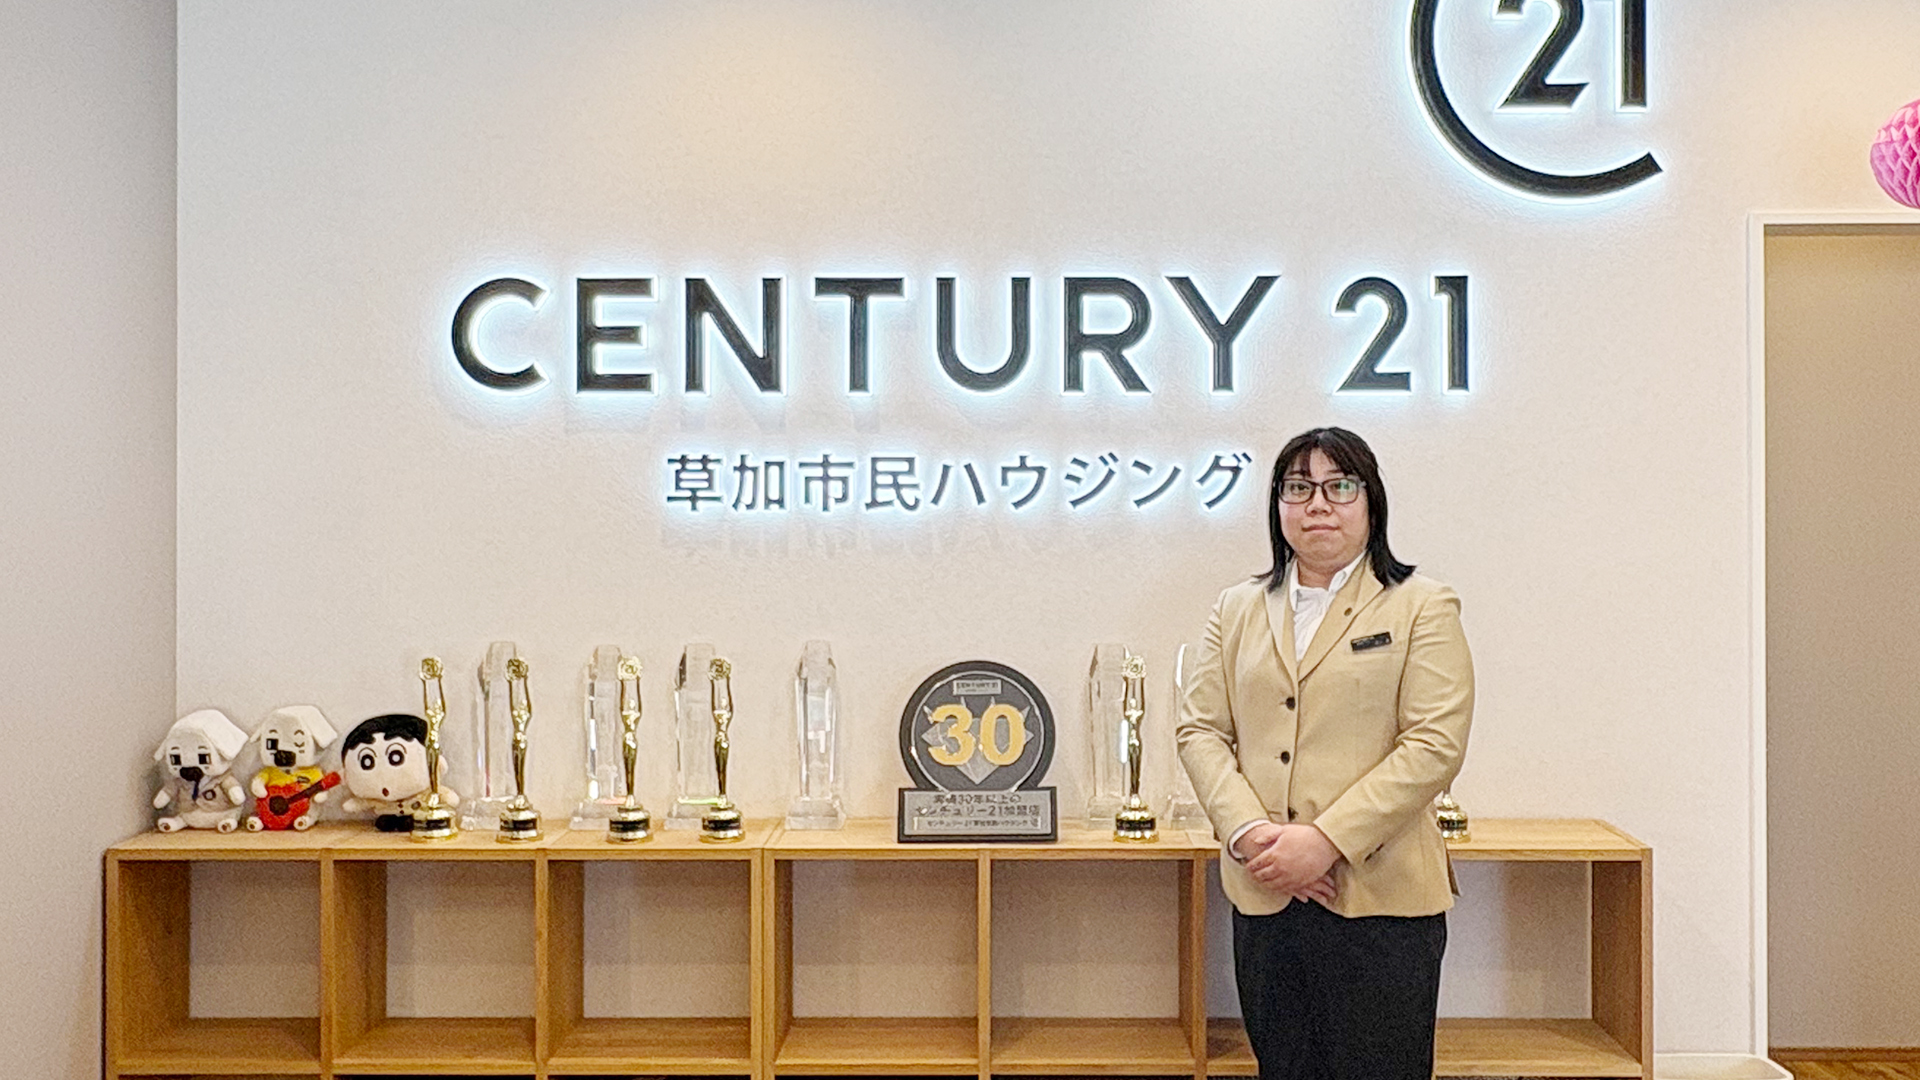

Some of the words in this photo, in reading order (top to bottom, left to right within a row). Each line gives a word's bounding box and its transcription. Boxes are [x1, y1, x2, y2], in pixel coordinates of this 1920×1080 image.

[451, 275, 1281, 393] CENTURY
[1334, 275, 1469, 393] 21
[667, 452, 1252, 512] 草加市民ハウジング
[928, 704, 1026, 766] 30
